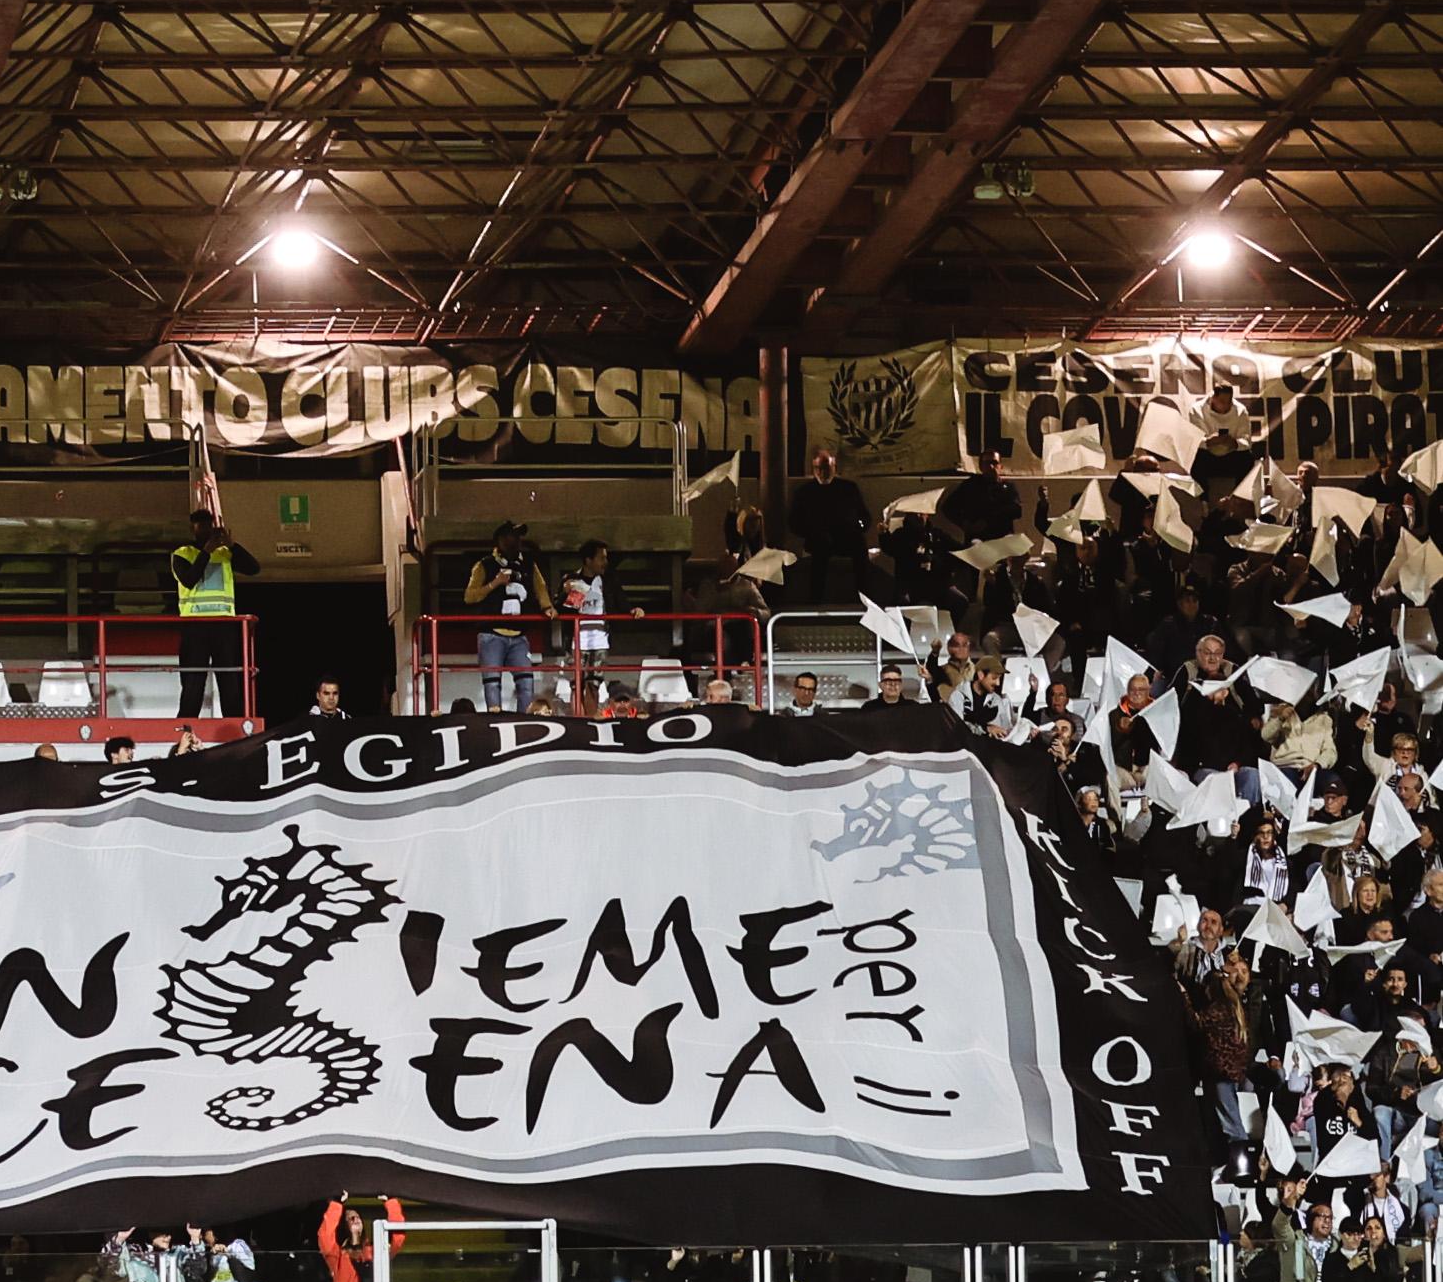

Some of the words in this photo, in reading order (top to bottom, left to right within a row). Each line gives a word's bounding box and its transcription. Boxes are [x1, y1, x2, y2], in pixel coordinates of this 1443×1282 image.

[513, 363, 760, 451] CESENA
[963, 351, 1261, 395] CESENA
[964, 392, 1014, 459] IL
[259, 712, 714, 790] EGIDIO
[1019, 807, 1149, 1003] KICK
[1091, 1035, 1171, 1196] OFF
